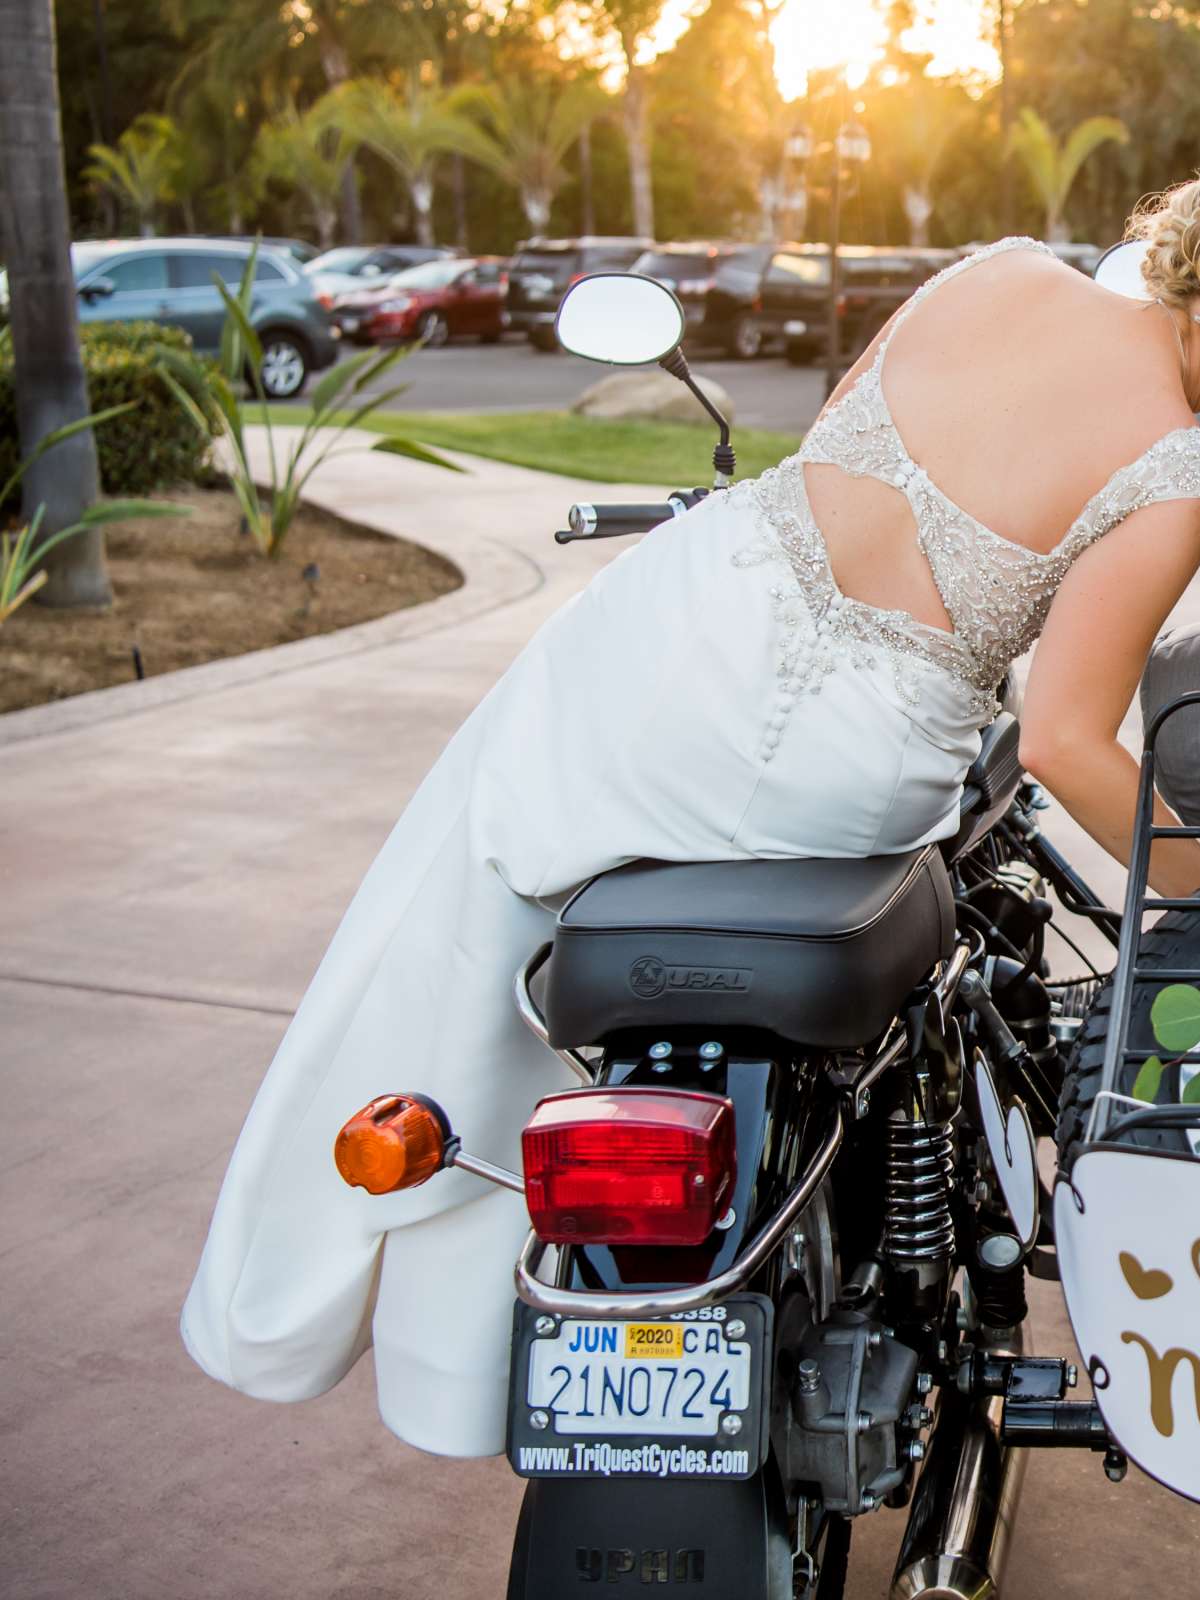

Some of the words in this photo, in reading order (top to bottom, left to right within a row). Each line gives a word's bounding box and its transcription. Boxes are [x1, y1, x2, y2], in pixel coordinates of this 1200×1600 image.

[669, 970, 748, 990] URAL
[568, 1326, 617, 1353] JUN
[636, 1328, 674, 1344] 2020
[548, 1364, 732, 1418] 21N0724
[519, 1442, 749, 1477] www.TriQuestCycles.com
